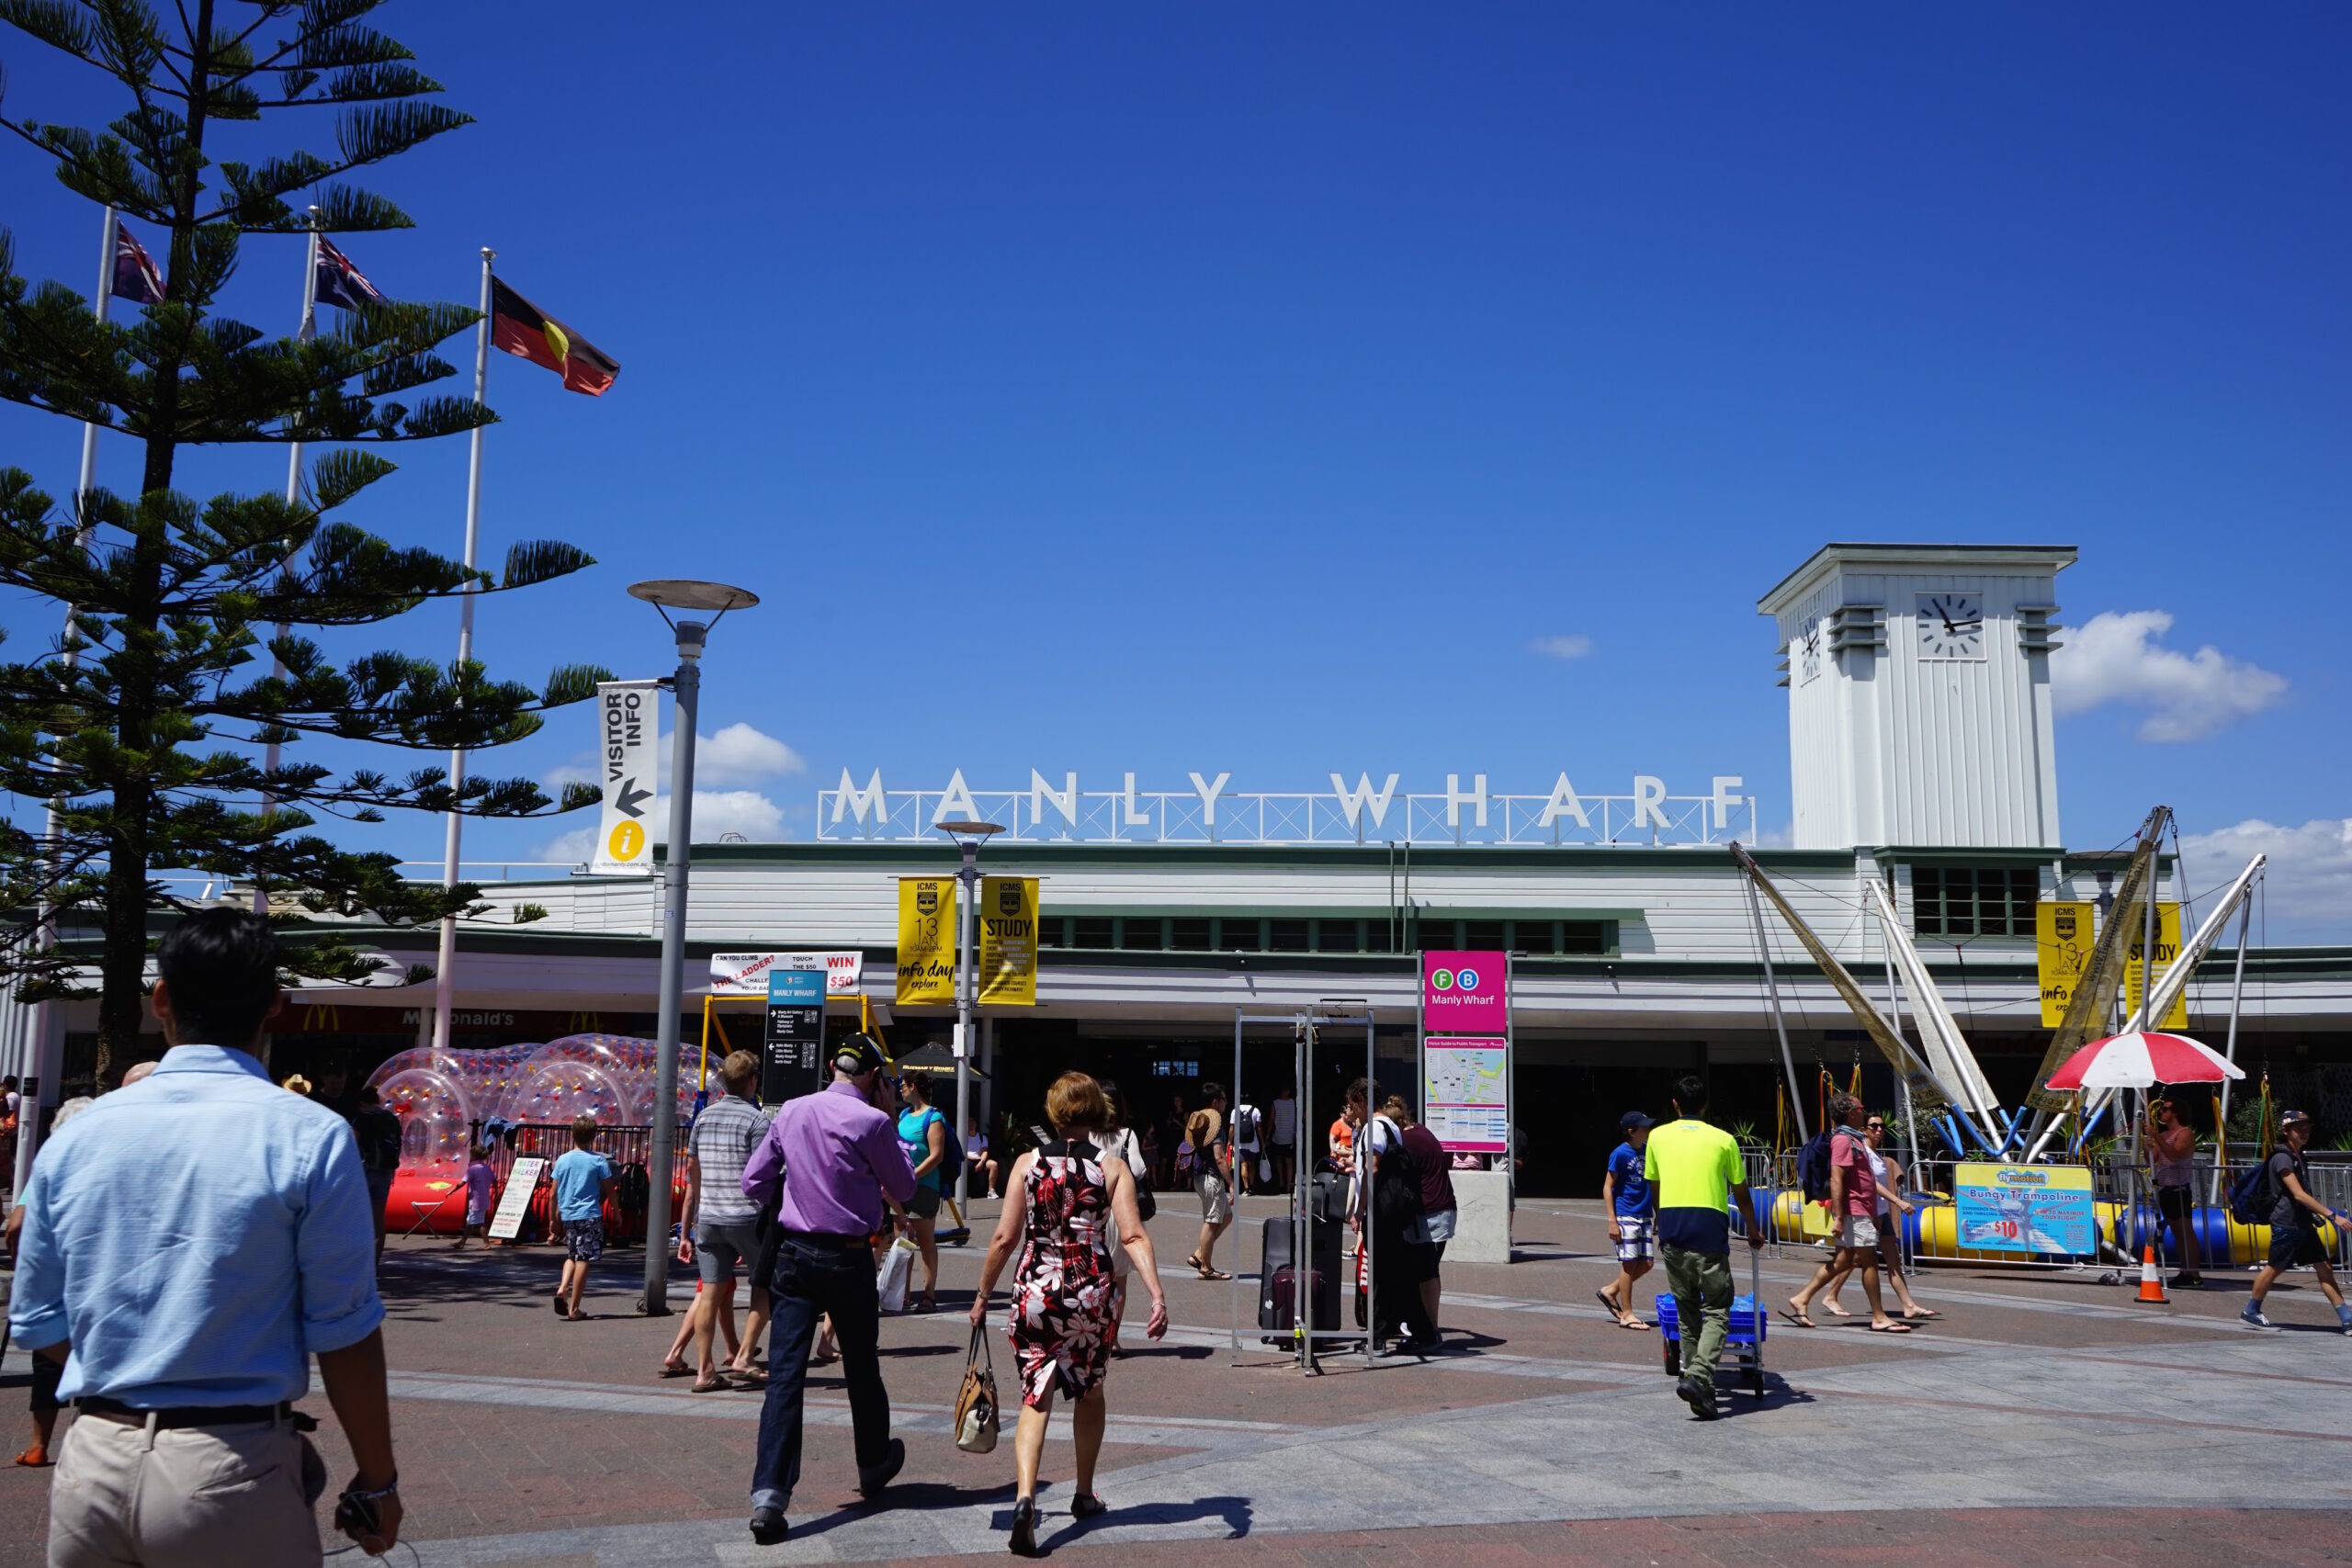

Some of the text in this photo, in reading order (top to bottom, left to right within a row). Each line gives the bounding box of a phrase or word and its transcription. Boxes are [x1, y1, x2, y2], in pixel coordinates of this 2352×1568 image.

[625, 693, 640, 746] INFO
[606, 694, 623, 783] VISITOR
[831, 767, 1743, 830] MANLY WHARF
[918, 883, 937, 891] ICMS
[1001, 883, 1021, 892] ICMS
[2055, 908, 2075, 916] ICMS
[914, 918, 938, 937] 13
[987, 919, 1032, 937] STUDY
[915, 936, 938, 947] JAN
[2054, 942, 2078, 961] 13
[827, 956, 854, 968] WIN
[713, 954, 775, 989] THE LADDER?
[899, 960, 954, 983] info day
[830, 976, 854, 987] $50
[911, 979, 938, 991] explore
[1440, 974, 1473, 986] F B
[2041, 986, 2067, 1000] info
[1432, 995, 1495, 1007] Manly Wharf
[402, 1010, 514, 1026] Monald's
[513, 1168, 540, 1177] WALKER
[1998, 1173, 2046, 1185] flymotion
[1970, 1189, 2079, 1201] Bungy Trampoline
[1995, 1221, 2018, 1238] $10
